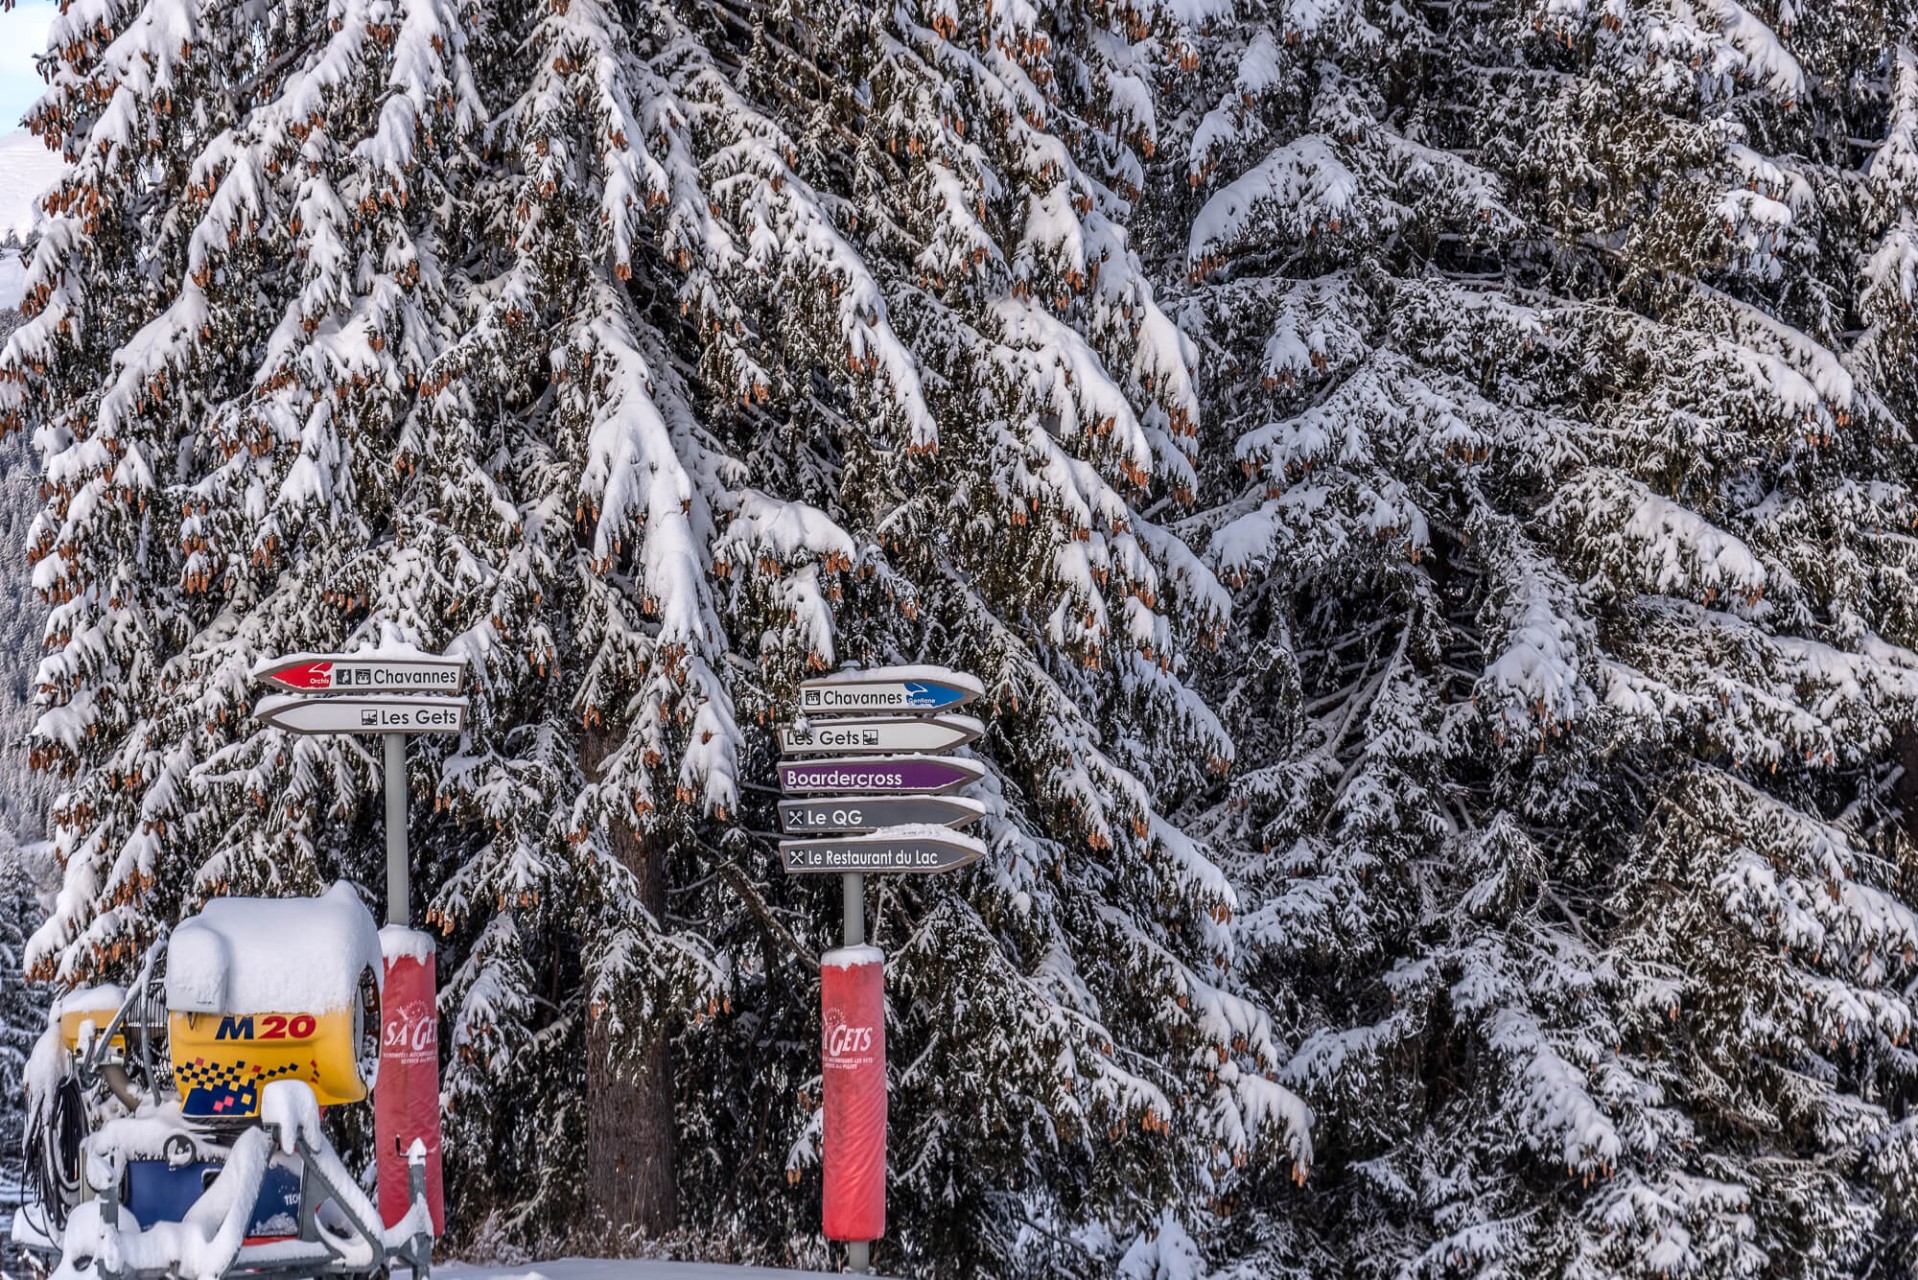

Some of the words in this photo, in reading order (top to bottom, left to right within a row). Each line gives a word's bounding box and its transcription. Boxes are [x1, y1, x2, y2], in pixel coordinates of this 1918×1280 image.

[310, 677, 329, 685] Orchis
[374, 669, 456, 684] Chavannes
[824, 690, 902, 705] Chavannes
[381, 709, 409, 725] Les
[415, 709, 457, 725] Gets
[787, 731, 814, 746] Les
[819, 731, 860, 746] Gets
[787, 770, 902, 786] Boardercross
[807, 810, 827, 825] Le
[832, 809, 863, 825] QG
[808, 850, 822, 865] Le
[826, 849, 892, 865] Restaurant
[895, 850, 912, 865] du
[915, 850, 938, 865] Lac
[829, 1024, 873, 1057] GETS
